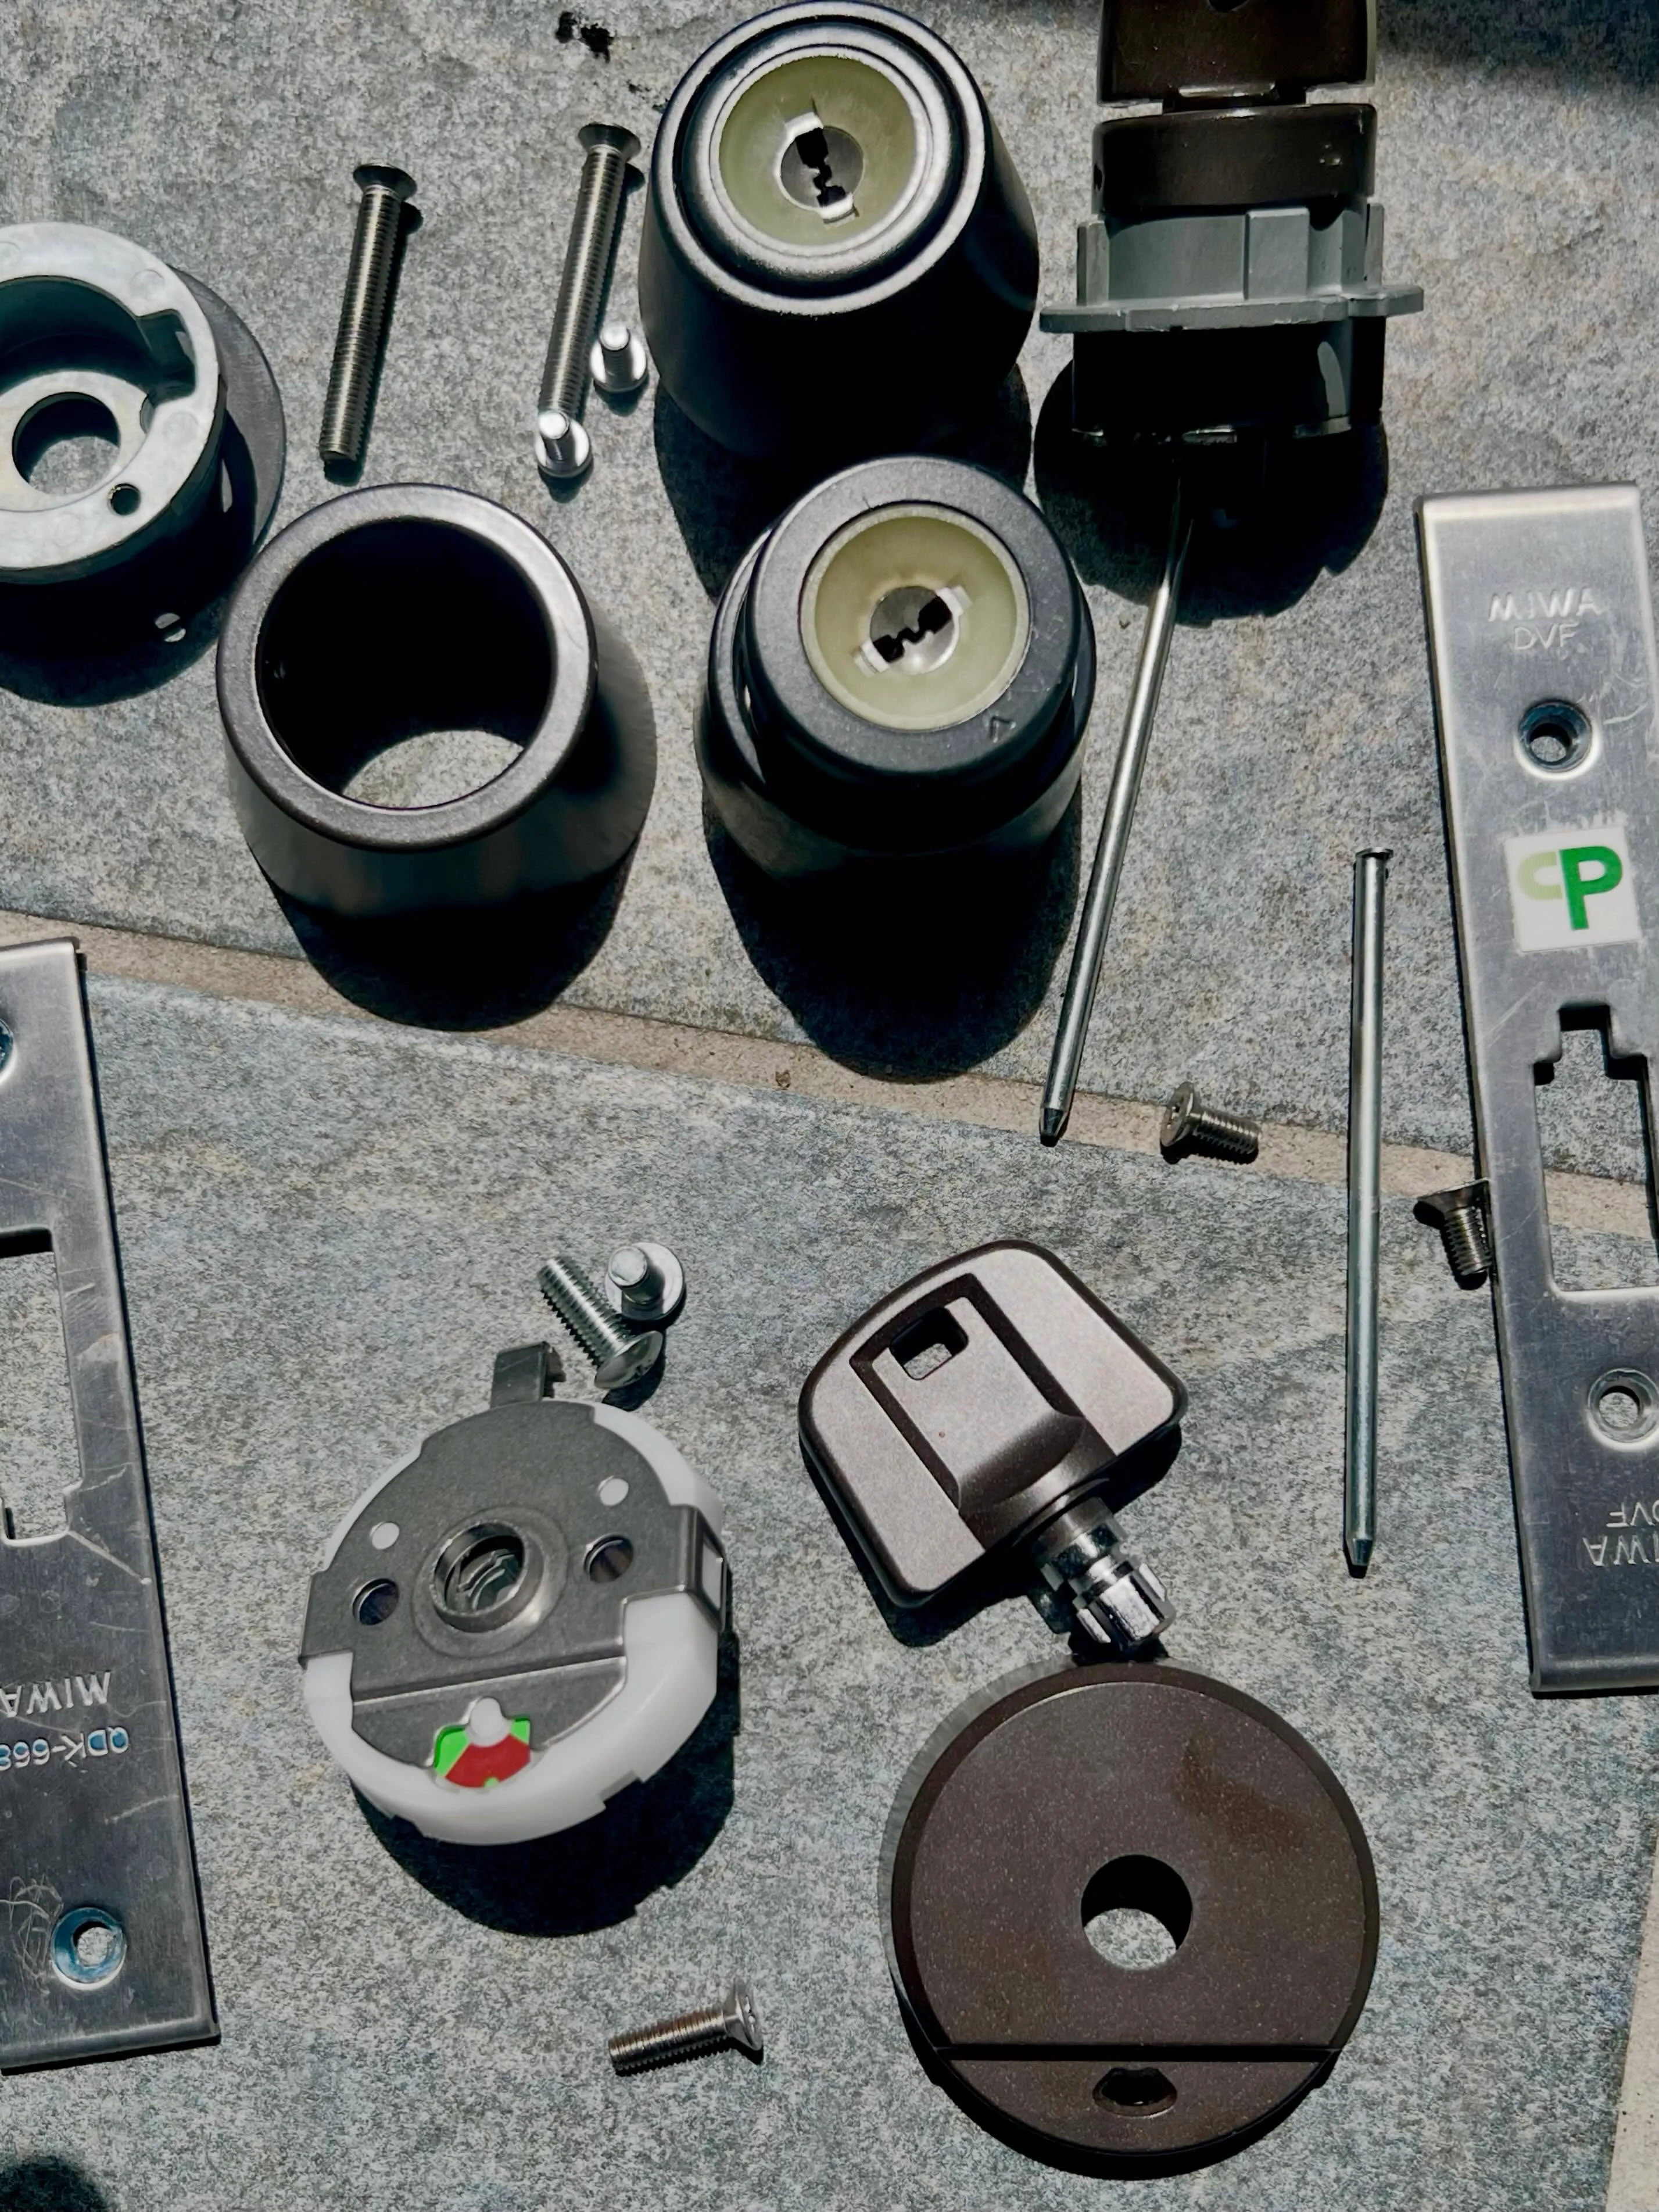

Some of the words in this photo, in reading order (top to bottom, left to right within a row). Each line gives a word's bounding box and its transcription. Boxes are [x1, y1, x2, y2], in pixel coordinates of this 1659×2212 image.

[1487, 586, 1604, 622] MIWA
[1513, 621, 1581, 650] DVF
[1606, 1499, 1659, 1527] VF
[0, 1670, 110, 1717] MIWA
